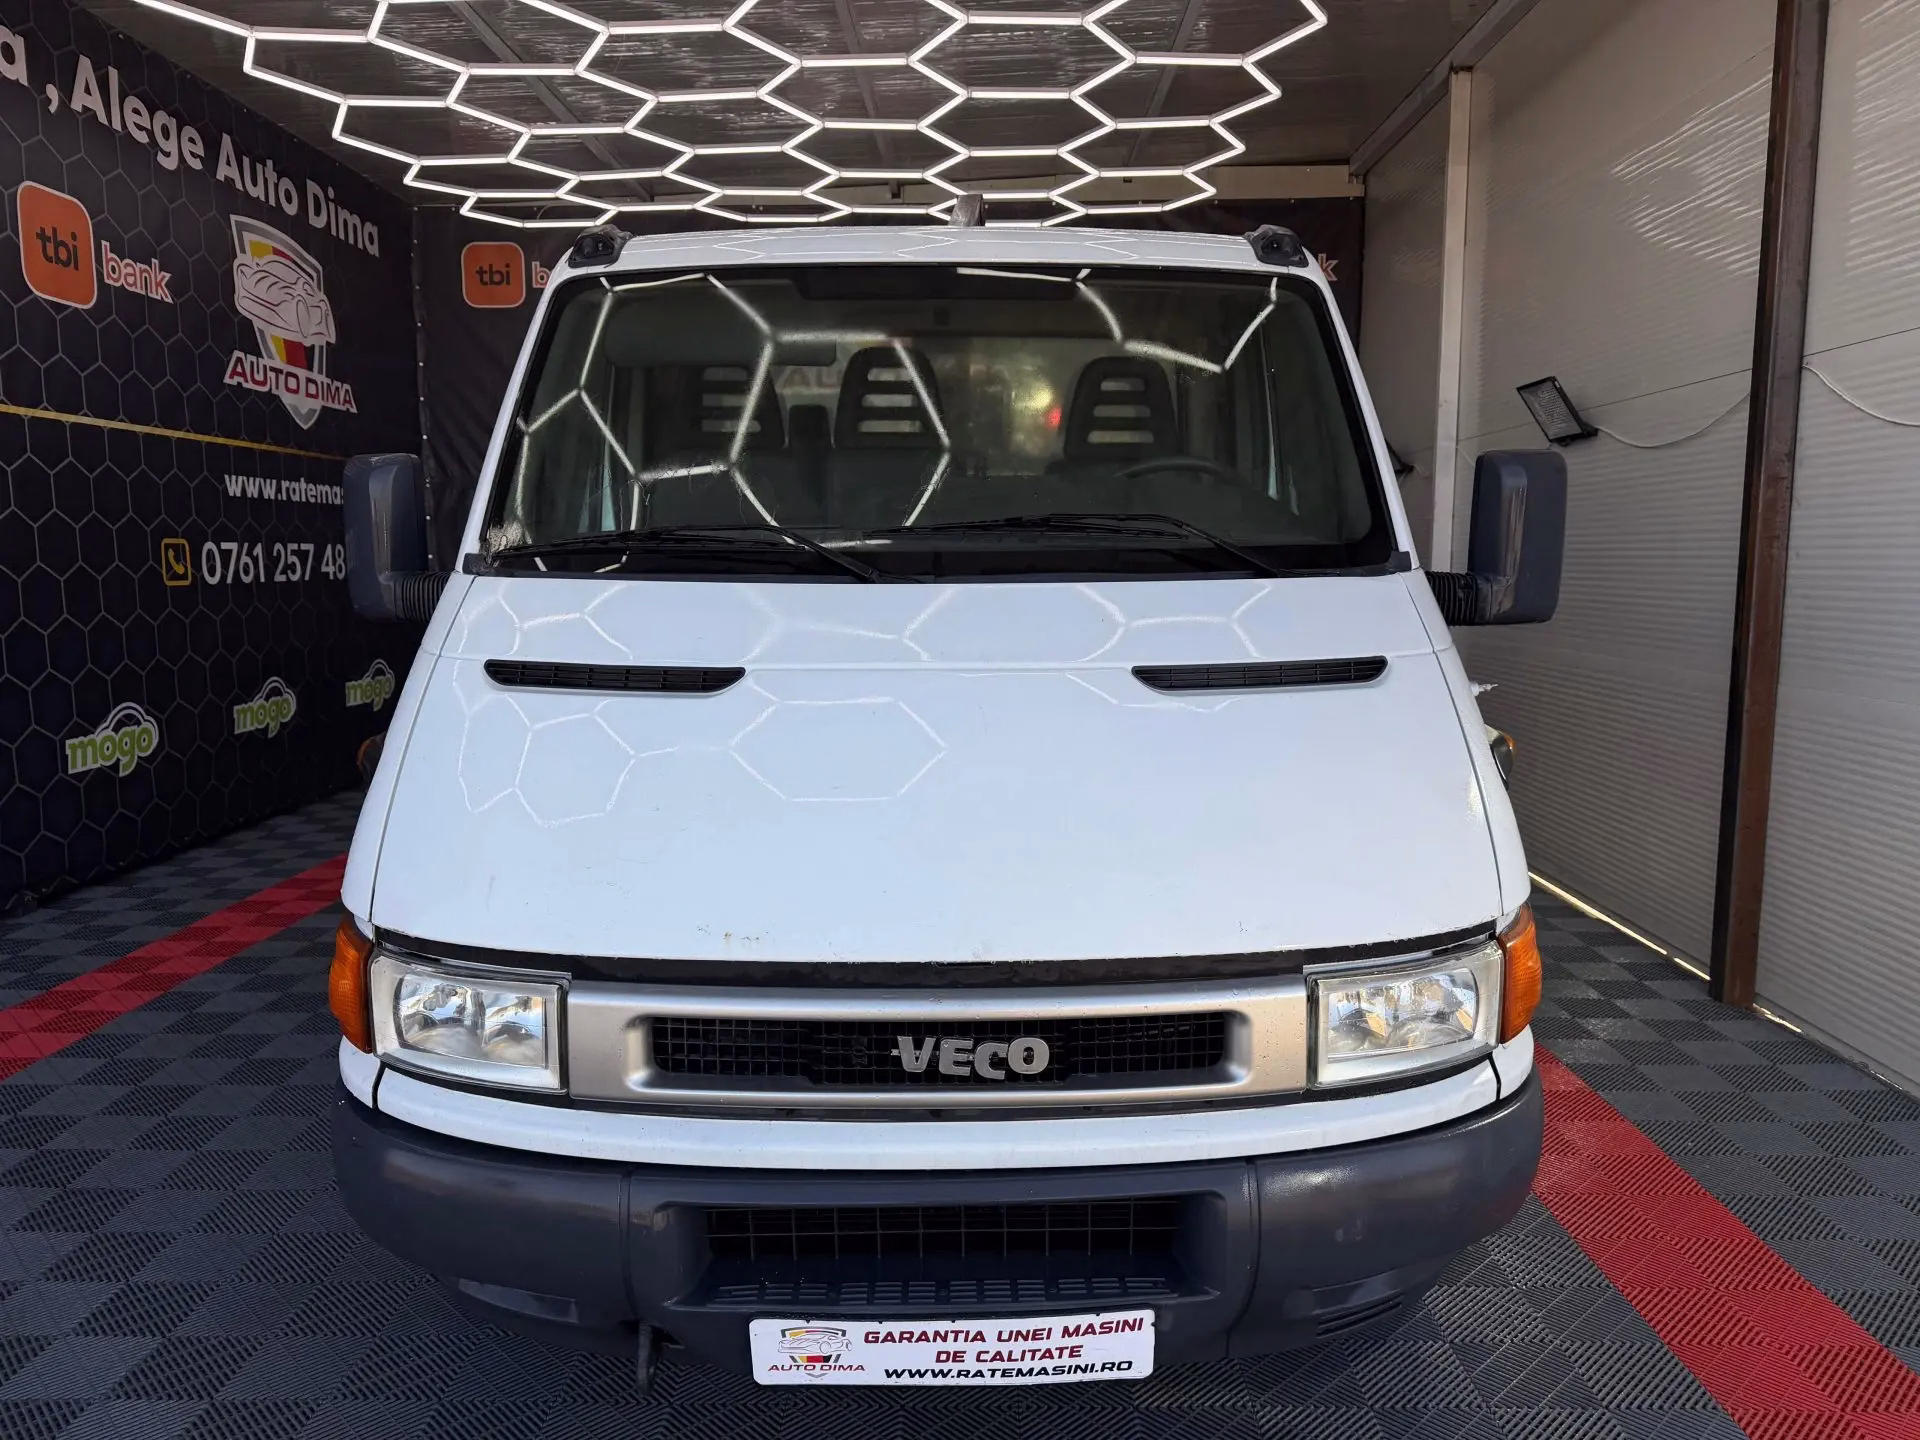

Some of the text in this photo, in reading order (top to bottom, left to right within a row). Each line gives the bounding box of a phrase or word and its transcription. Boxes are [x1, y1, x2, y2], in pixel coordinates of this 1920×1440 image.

[71, 54, 205, 171] Alege
[216, 132, 299, 216] Auto
[306, 179, 380, 258] Dima
[35, 226, 173, 304] tbi bank
[475, 263, 511, 286] tbi
[227, 353, 355, 410] AUTO DIMA
[202, 541, 346, 585] 0761 257 48
[346, 675, 394, 711] mogo
[234, 695, 296, 738] mogo
[66, 723, 156, 777] mogo
[897, 1035, 1050, 1080] VECO
[863, 1317, 1144, 1344] GARANTIA UNEI MASINI
[768, 1363, 865, 1372] AUTO DIMA
[884, 1360, 1133, 1379] WWW.RATEMASINI.RO
[935, 1344, 1084, 1364] DE CALITATE
